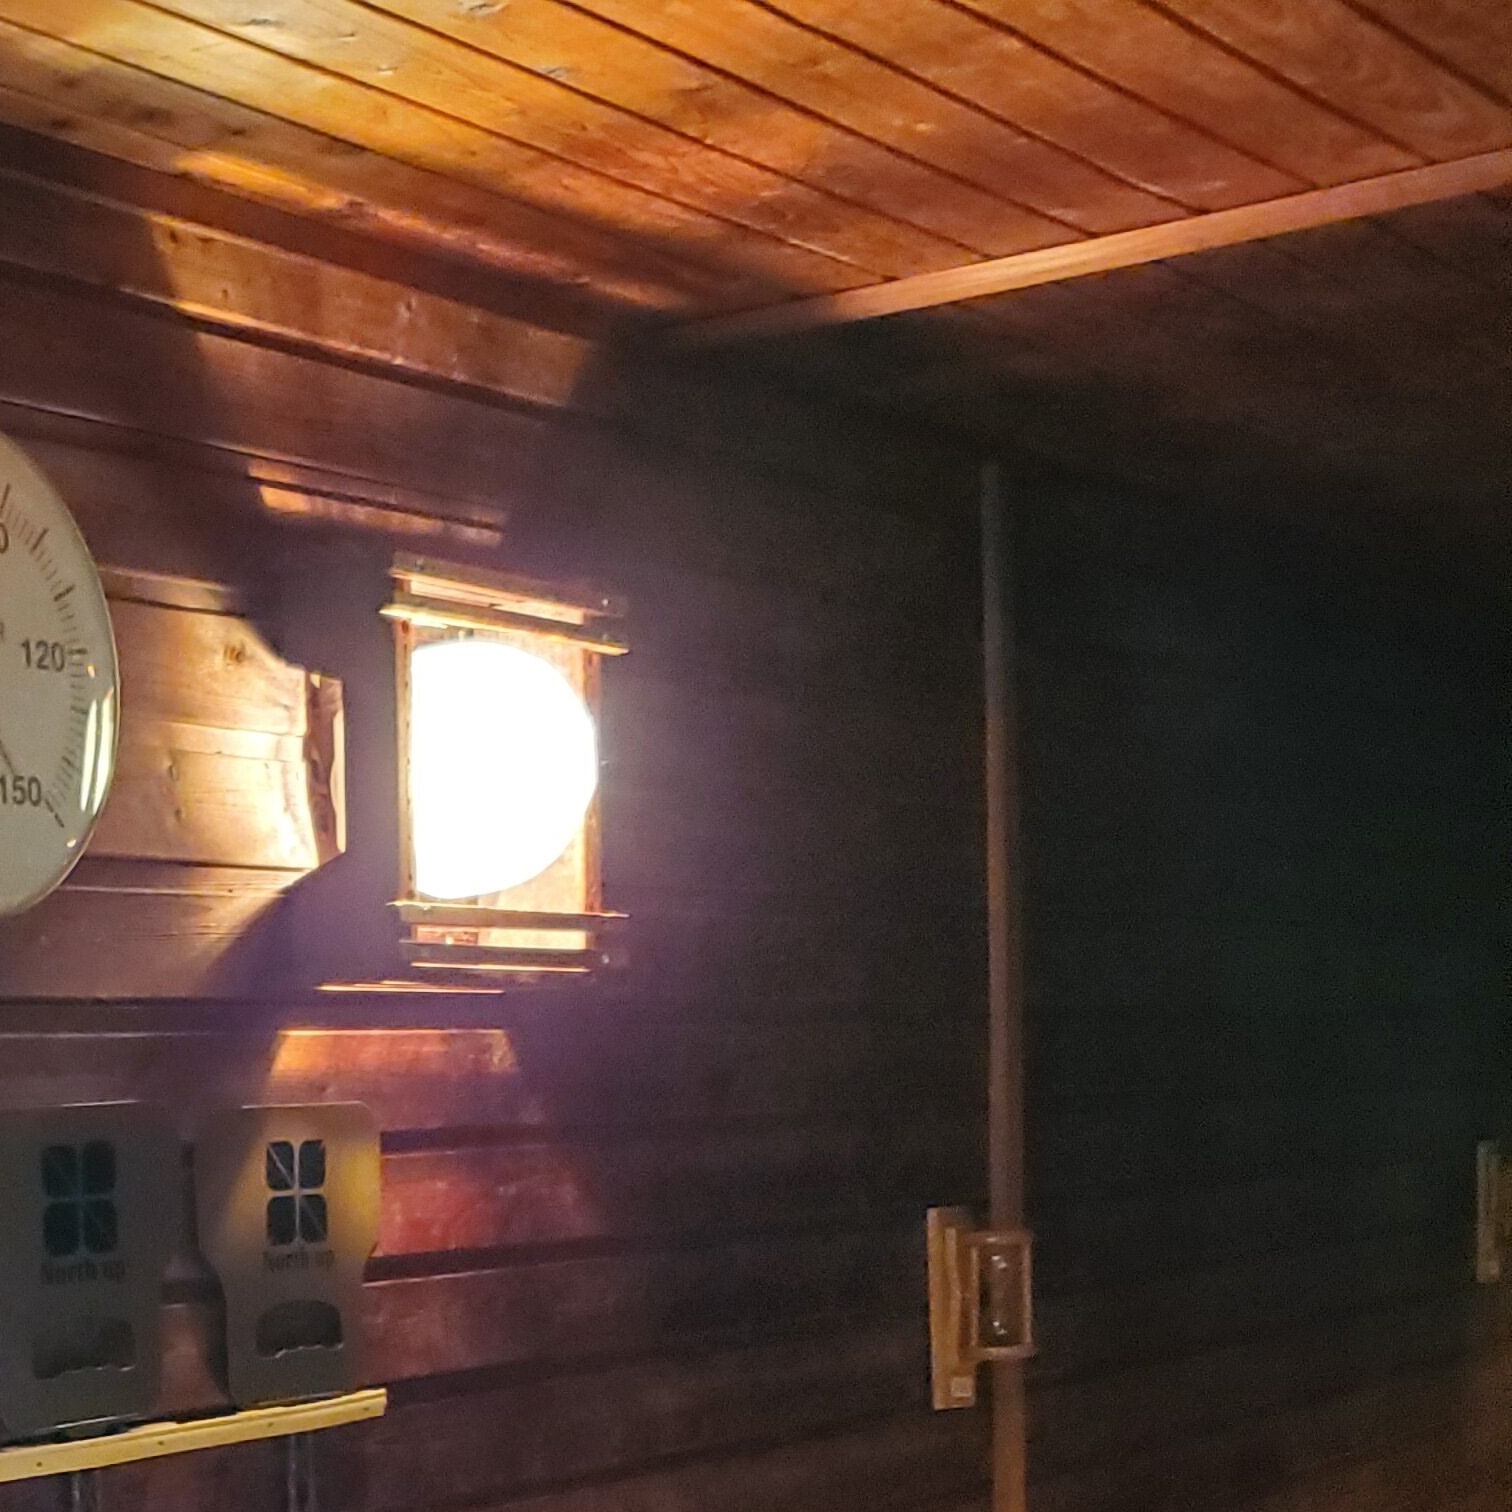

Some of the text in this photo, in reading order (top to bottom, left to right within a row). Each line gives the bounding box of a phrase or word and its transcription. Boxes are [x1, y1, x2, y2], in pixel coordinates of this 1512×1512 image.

[22, 640, 65, 673] 120
[40, 1256, 126, 1285] North up
[262, 1246, 335, 1273] North up
